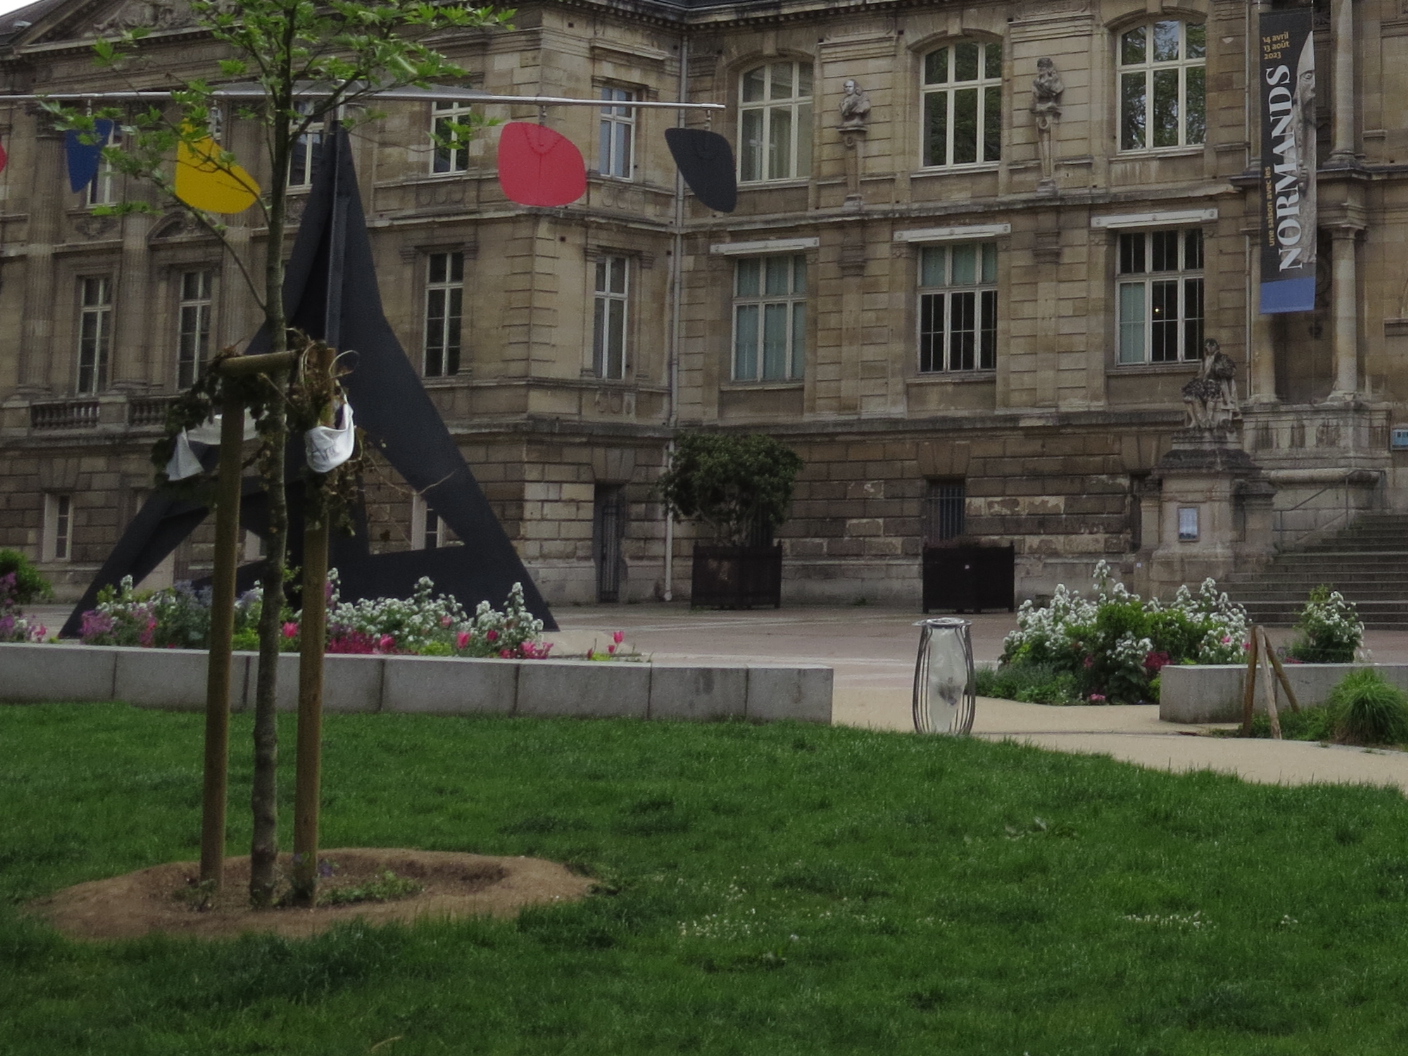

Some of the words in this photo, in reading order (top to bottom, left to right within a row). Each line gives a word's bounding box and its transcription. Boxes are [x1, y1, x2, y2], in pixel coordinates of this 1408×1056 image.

[1262, 36, 1271, 44] 14
[1272, 31, 1289, 42] avril
[1263, 45, 1271, 53] 13
[1272, 40, 1290, 50] août
[1264, 51, 1282, 60] 2023
[1264, 166, 1272, 179] les
[1265, 64, 1304, 273] NORMANDS
[1265, 179, 1273, 200] avec
[1266, 201, 1275, 228] saison
